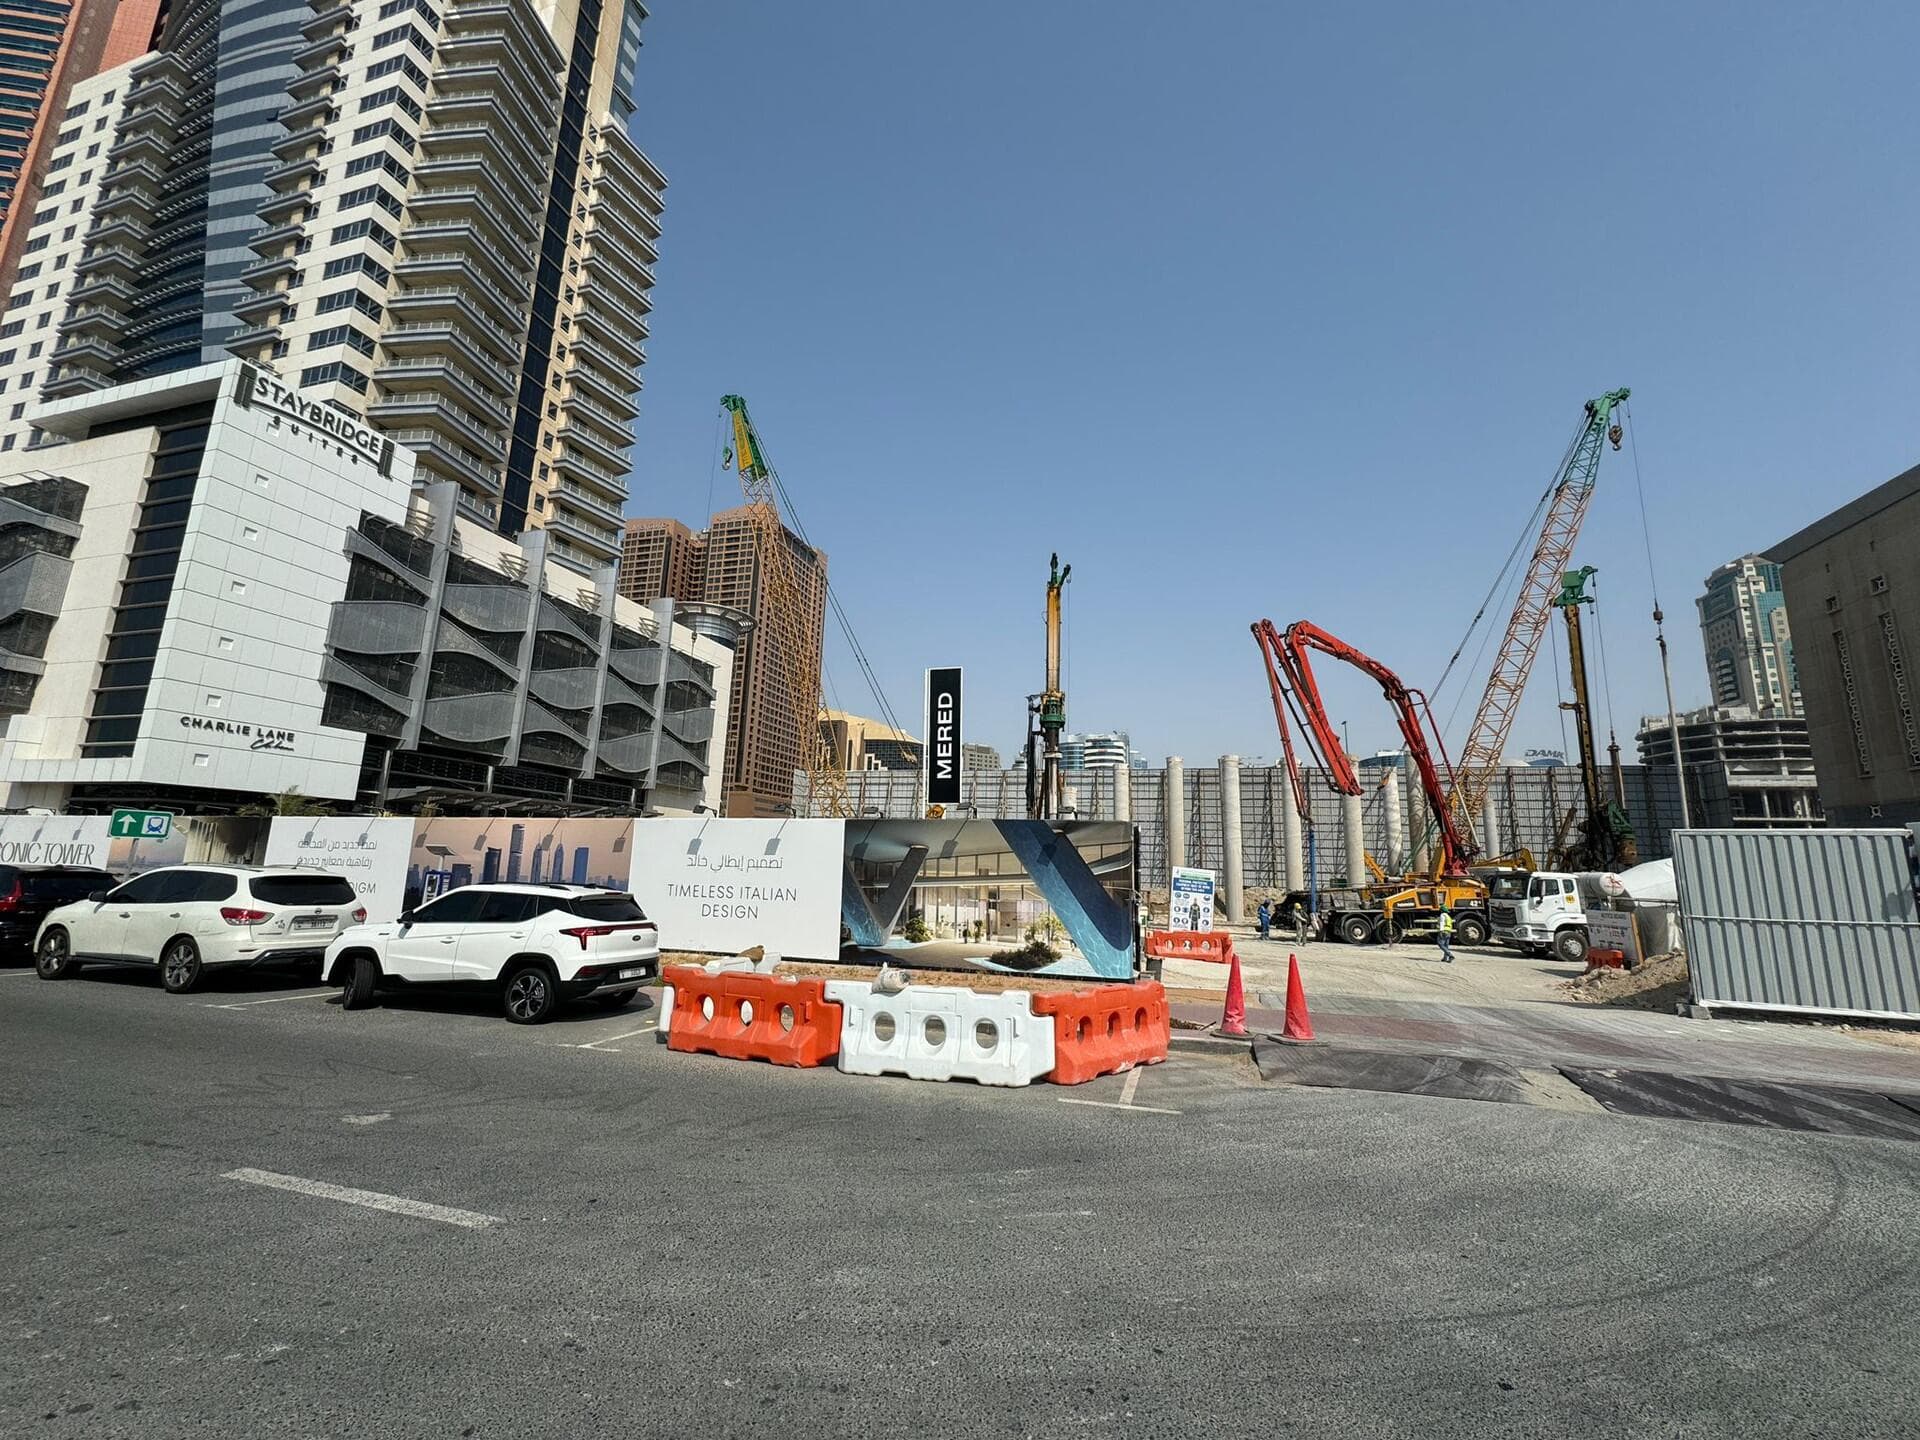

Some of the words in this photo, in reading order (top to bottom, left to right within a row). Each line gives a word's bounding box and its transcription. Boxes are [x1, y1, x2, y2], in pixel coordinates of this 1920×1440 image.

[255, 376, 380, 454] STAYBRIDGE
[272, 415, 358, 464] SUITES
[180, 716, 251, 737] CHARLIE
[257, 728, 295, 742] LANE
[936, 691, 953, 780] MERED
[0, 841, 42, 864] ONIC
[43, 842, 95, 865] TOWER
[746, 856, 784, 873] تصميم
[667, 883, 734, 899] TIMELESS
[740, 886, 797, 901] ITALIAN
[701, 903, 758, 919] DESIGN
